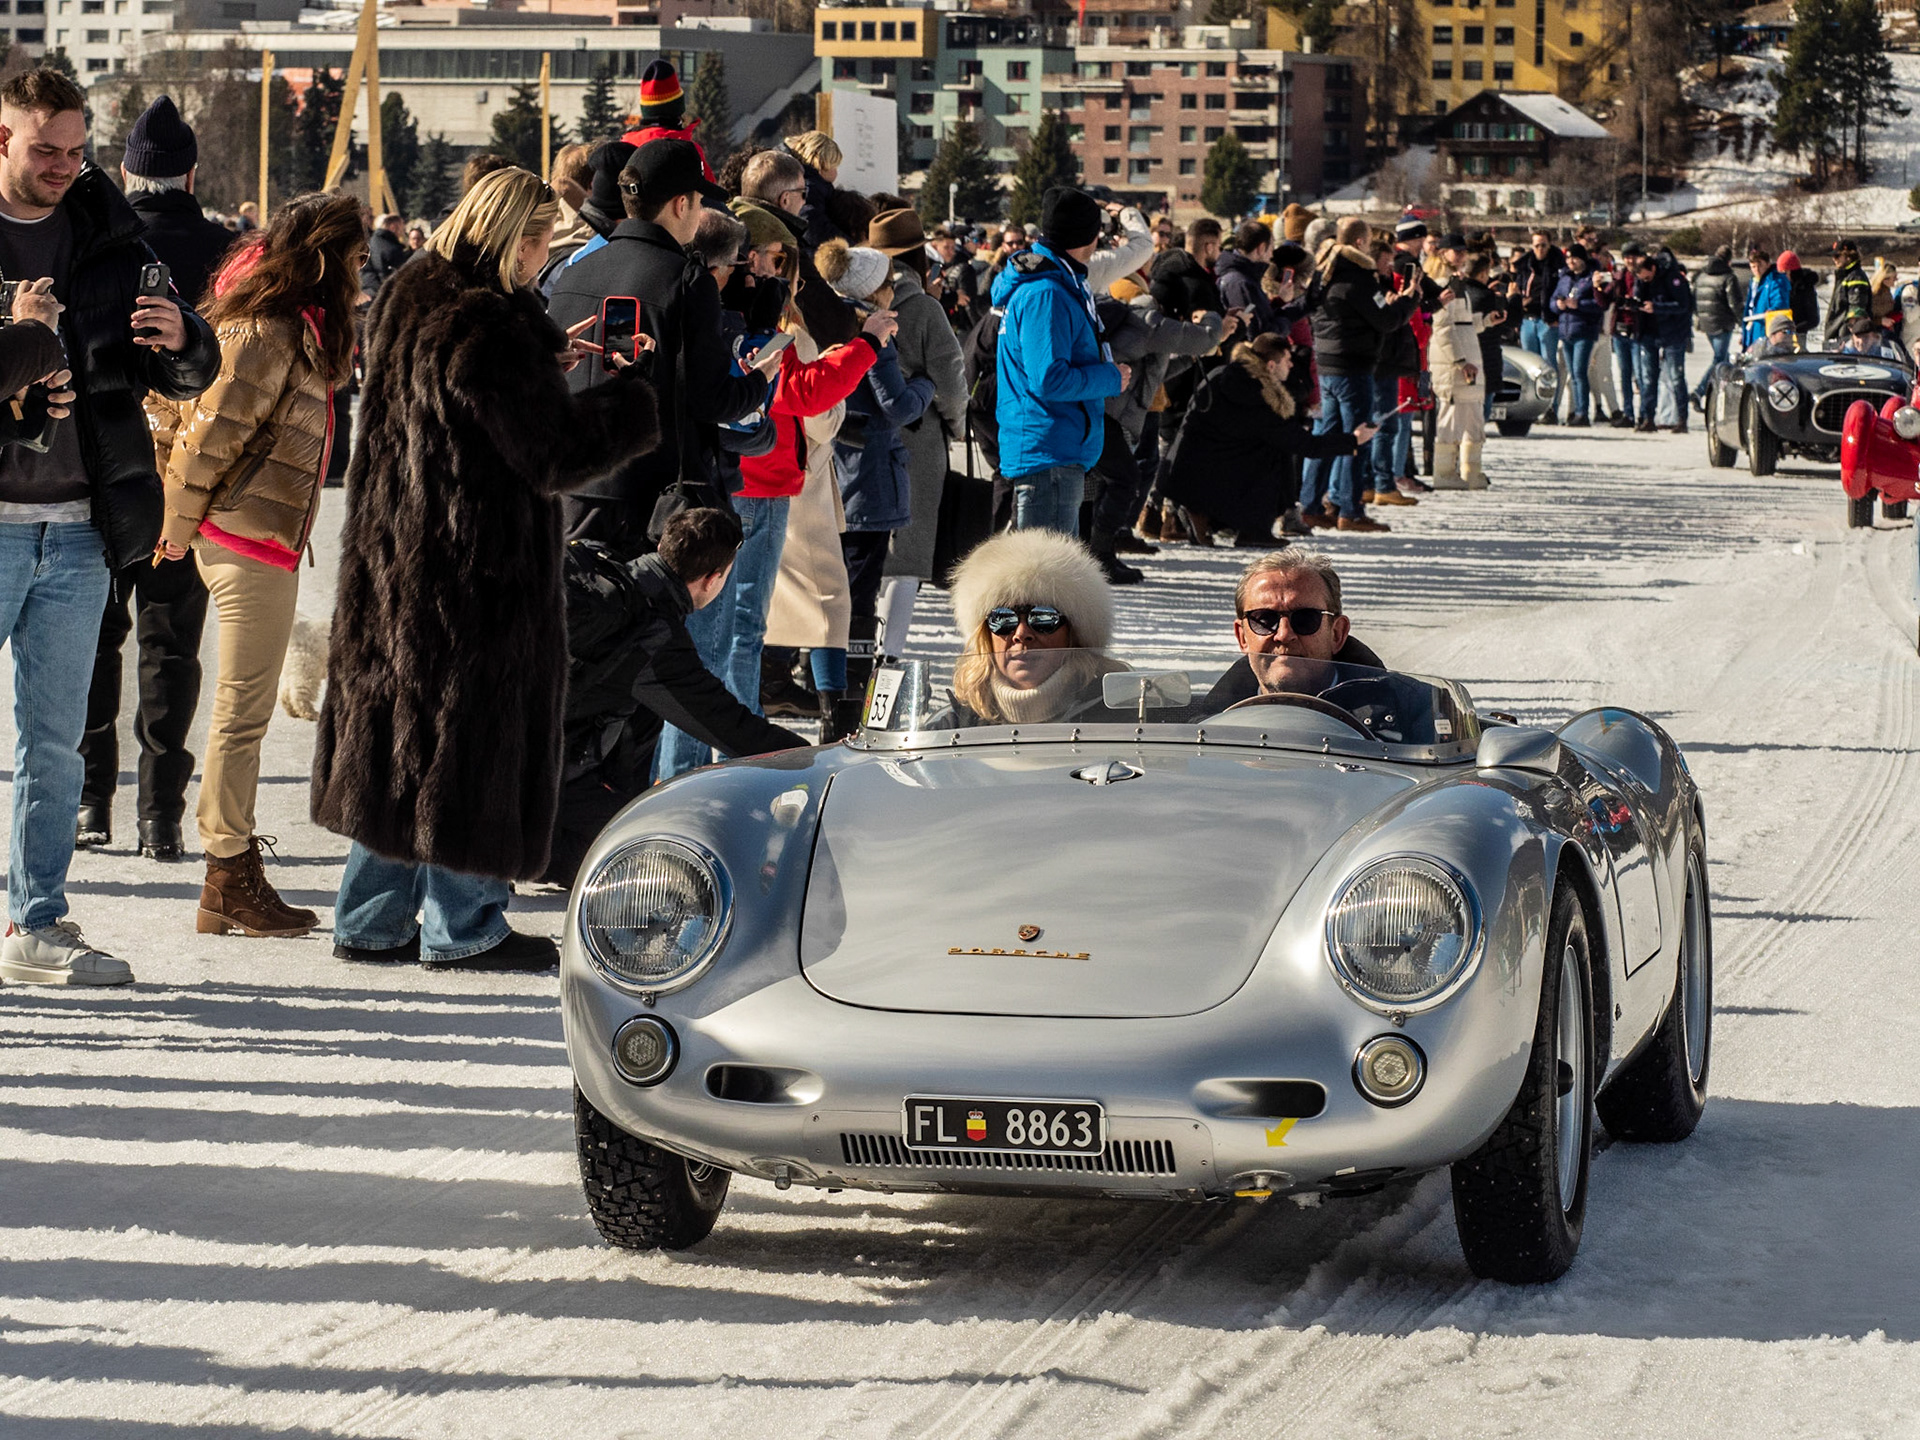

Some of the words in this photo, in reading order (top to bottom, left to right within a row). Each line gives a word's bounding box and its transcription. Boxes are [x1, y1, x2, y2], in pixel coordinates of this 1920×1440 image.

[871, 693, 890, 722] 53
[948, 946, 1091, 961] PORSCHE
[914, 1105, 958, 1143] FL
[1005, 1108, 1093, 1148] 8863
